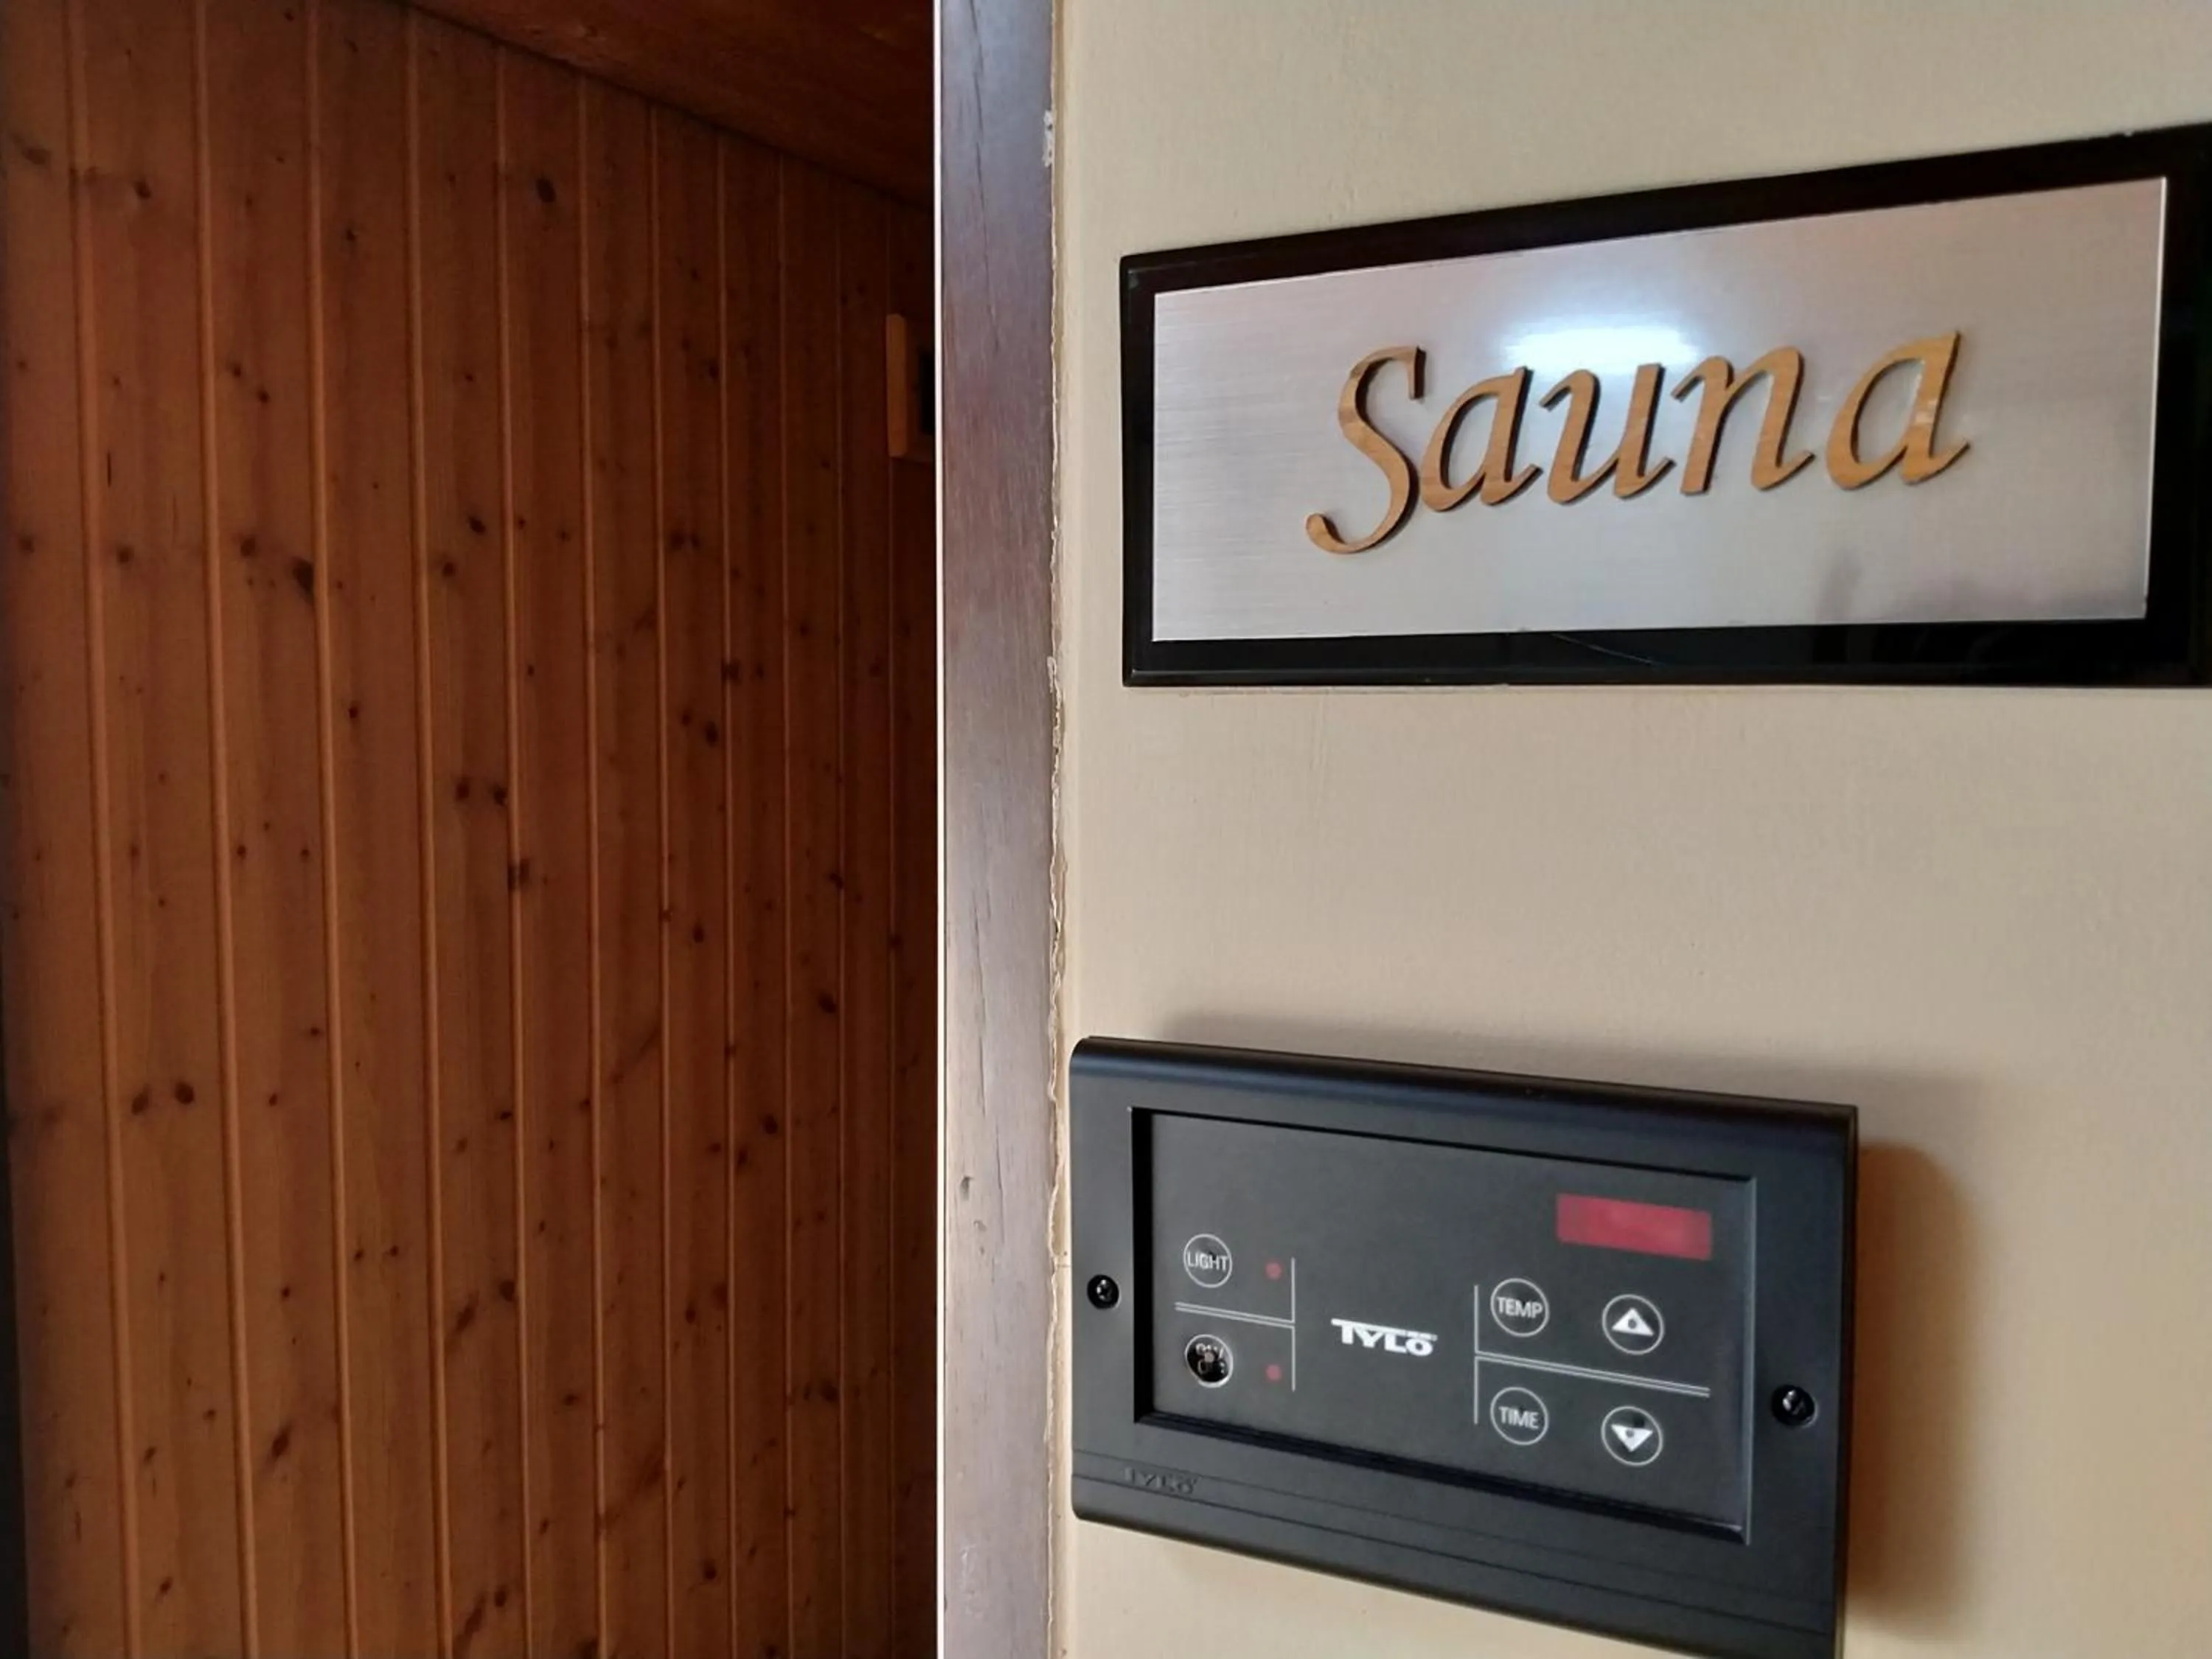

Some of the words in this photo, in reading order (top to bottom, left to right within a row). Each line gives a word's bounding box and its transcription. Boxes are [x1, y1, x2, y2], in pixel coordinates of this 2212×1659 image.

[1304, 330, 1971, 555] Sauna
[1187, 1251, 1230, 1271] LIGHT
[1497, 1296, 1543, 1318] TEMP
[1498, 1406, 1540, 1430] TIME
